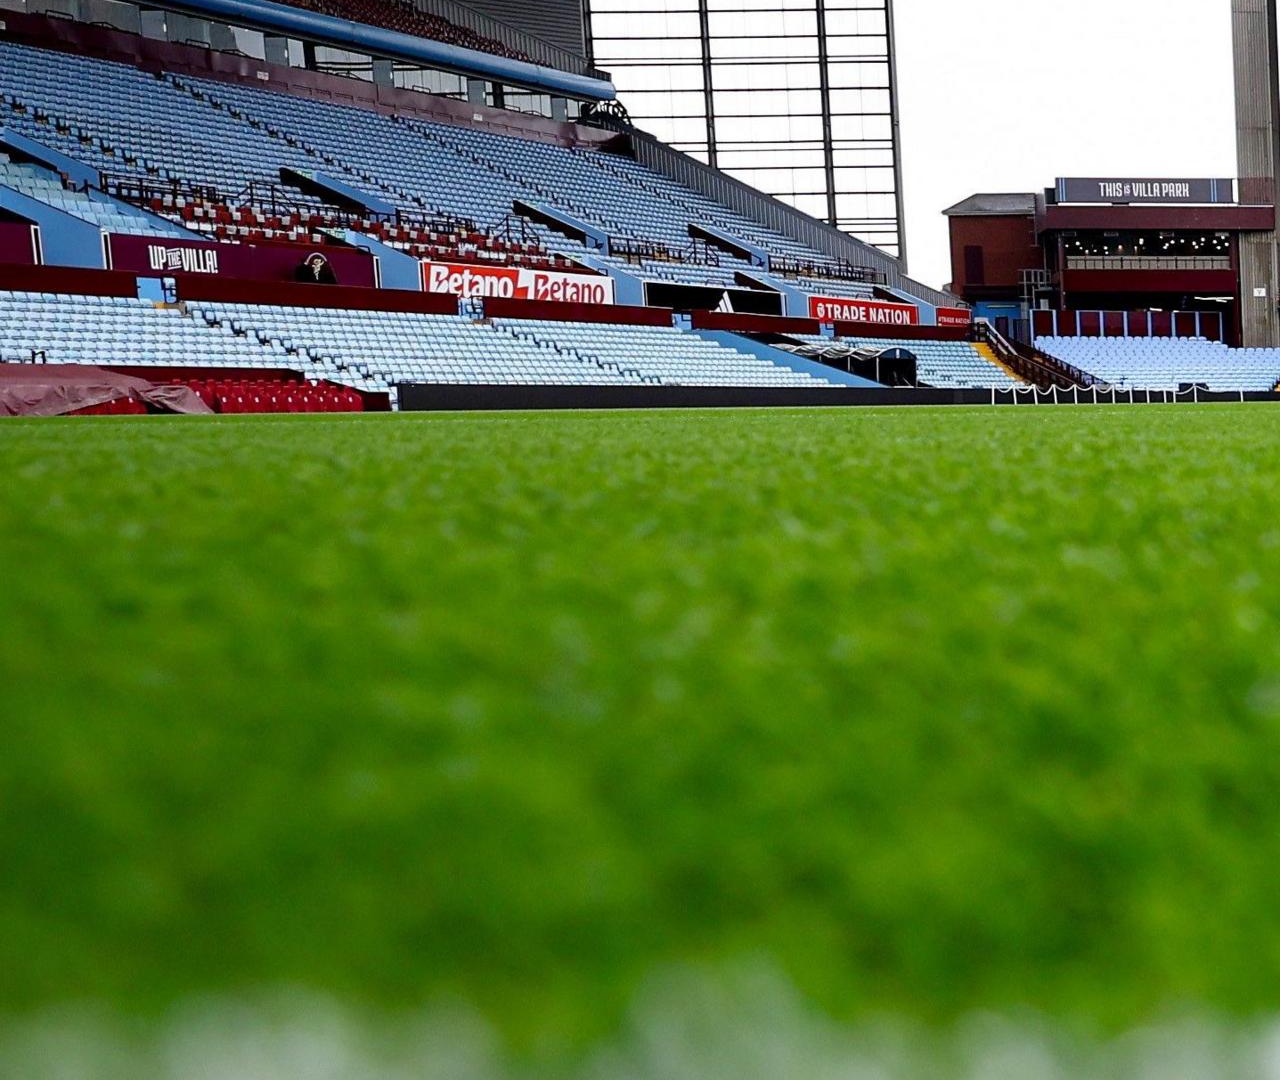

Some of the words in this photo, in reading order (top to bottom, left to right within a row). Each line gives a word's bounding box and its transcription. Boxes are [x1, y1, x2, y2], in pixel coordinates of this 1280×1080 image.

[1098, 182, 1123, 197] THIS
[1132, 182, 1161, 197] VILLA
[1162, 182, 1190, 197] PARK
[148, 245, 167, 269] UP
[167, 248, 181, 269] THE
[181, 247, 219, 274] VILLA!
[429, 265, 514, 298] Betano
[534, 274, 605, 304] Betano
[826, 304, 867, 321] TRADE
[869, 307, 911, 325] NATION
